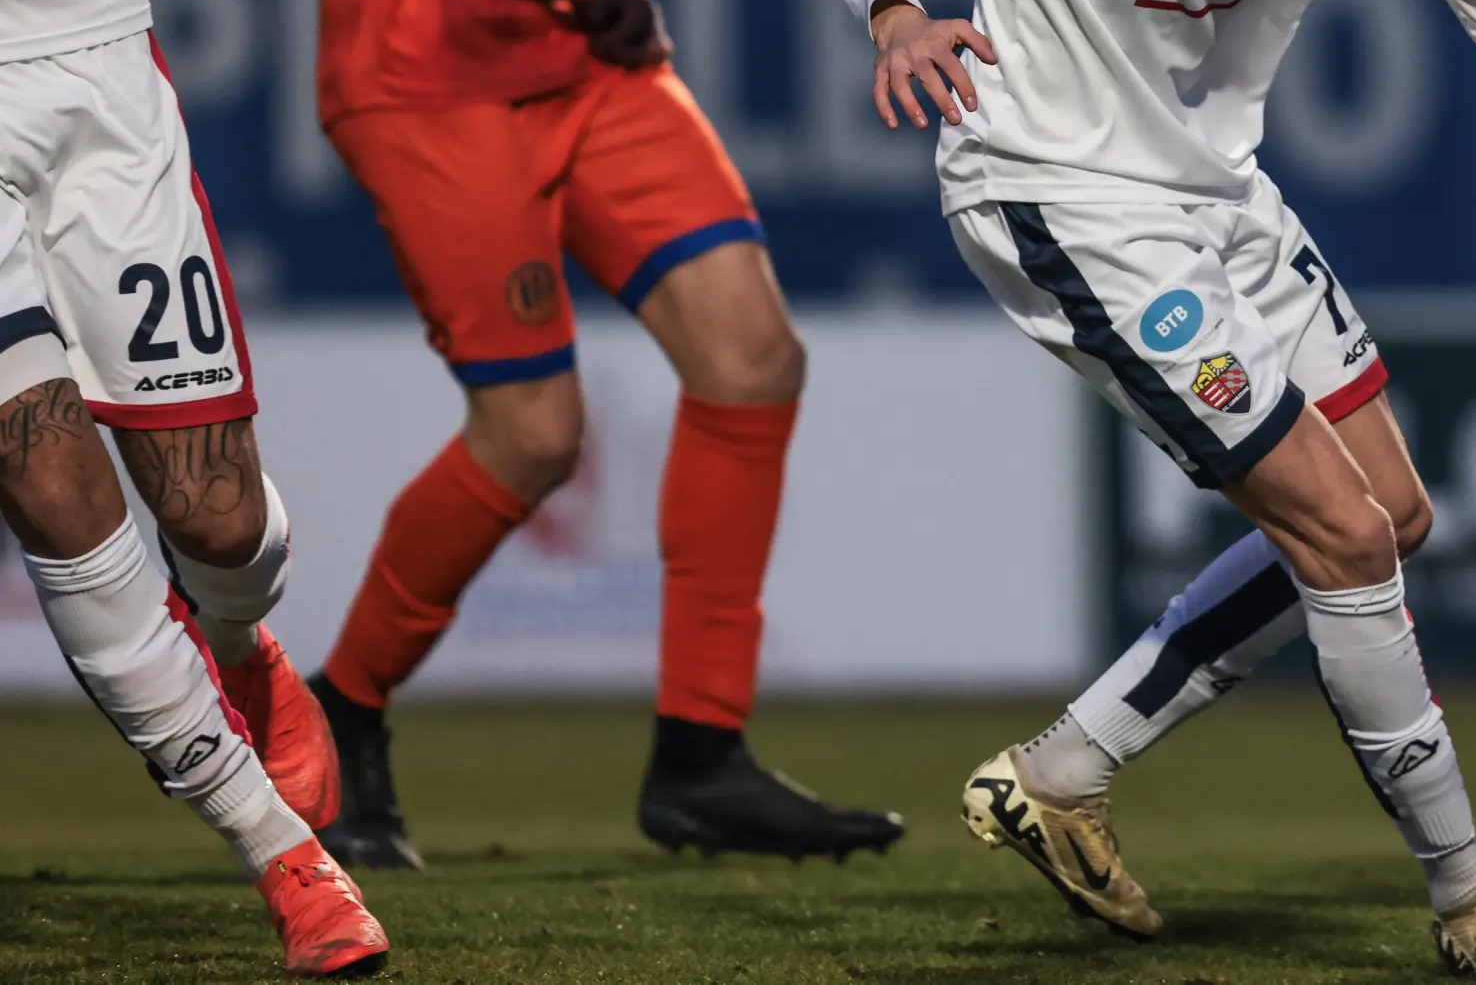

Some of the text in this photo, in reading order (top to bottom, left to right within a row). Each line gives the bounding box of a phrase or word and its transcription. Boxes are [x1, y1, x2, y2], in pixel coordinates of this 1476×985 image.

[118, 254, 226, 363] 20
[1154, 305, 1189, 338] BTB
[1289, 243, 1349, 337] 7
[133, 366, 234, 392] ACERBIS
